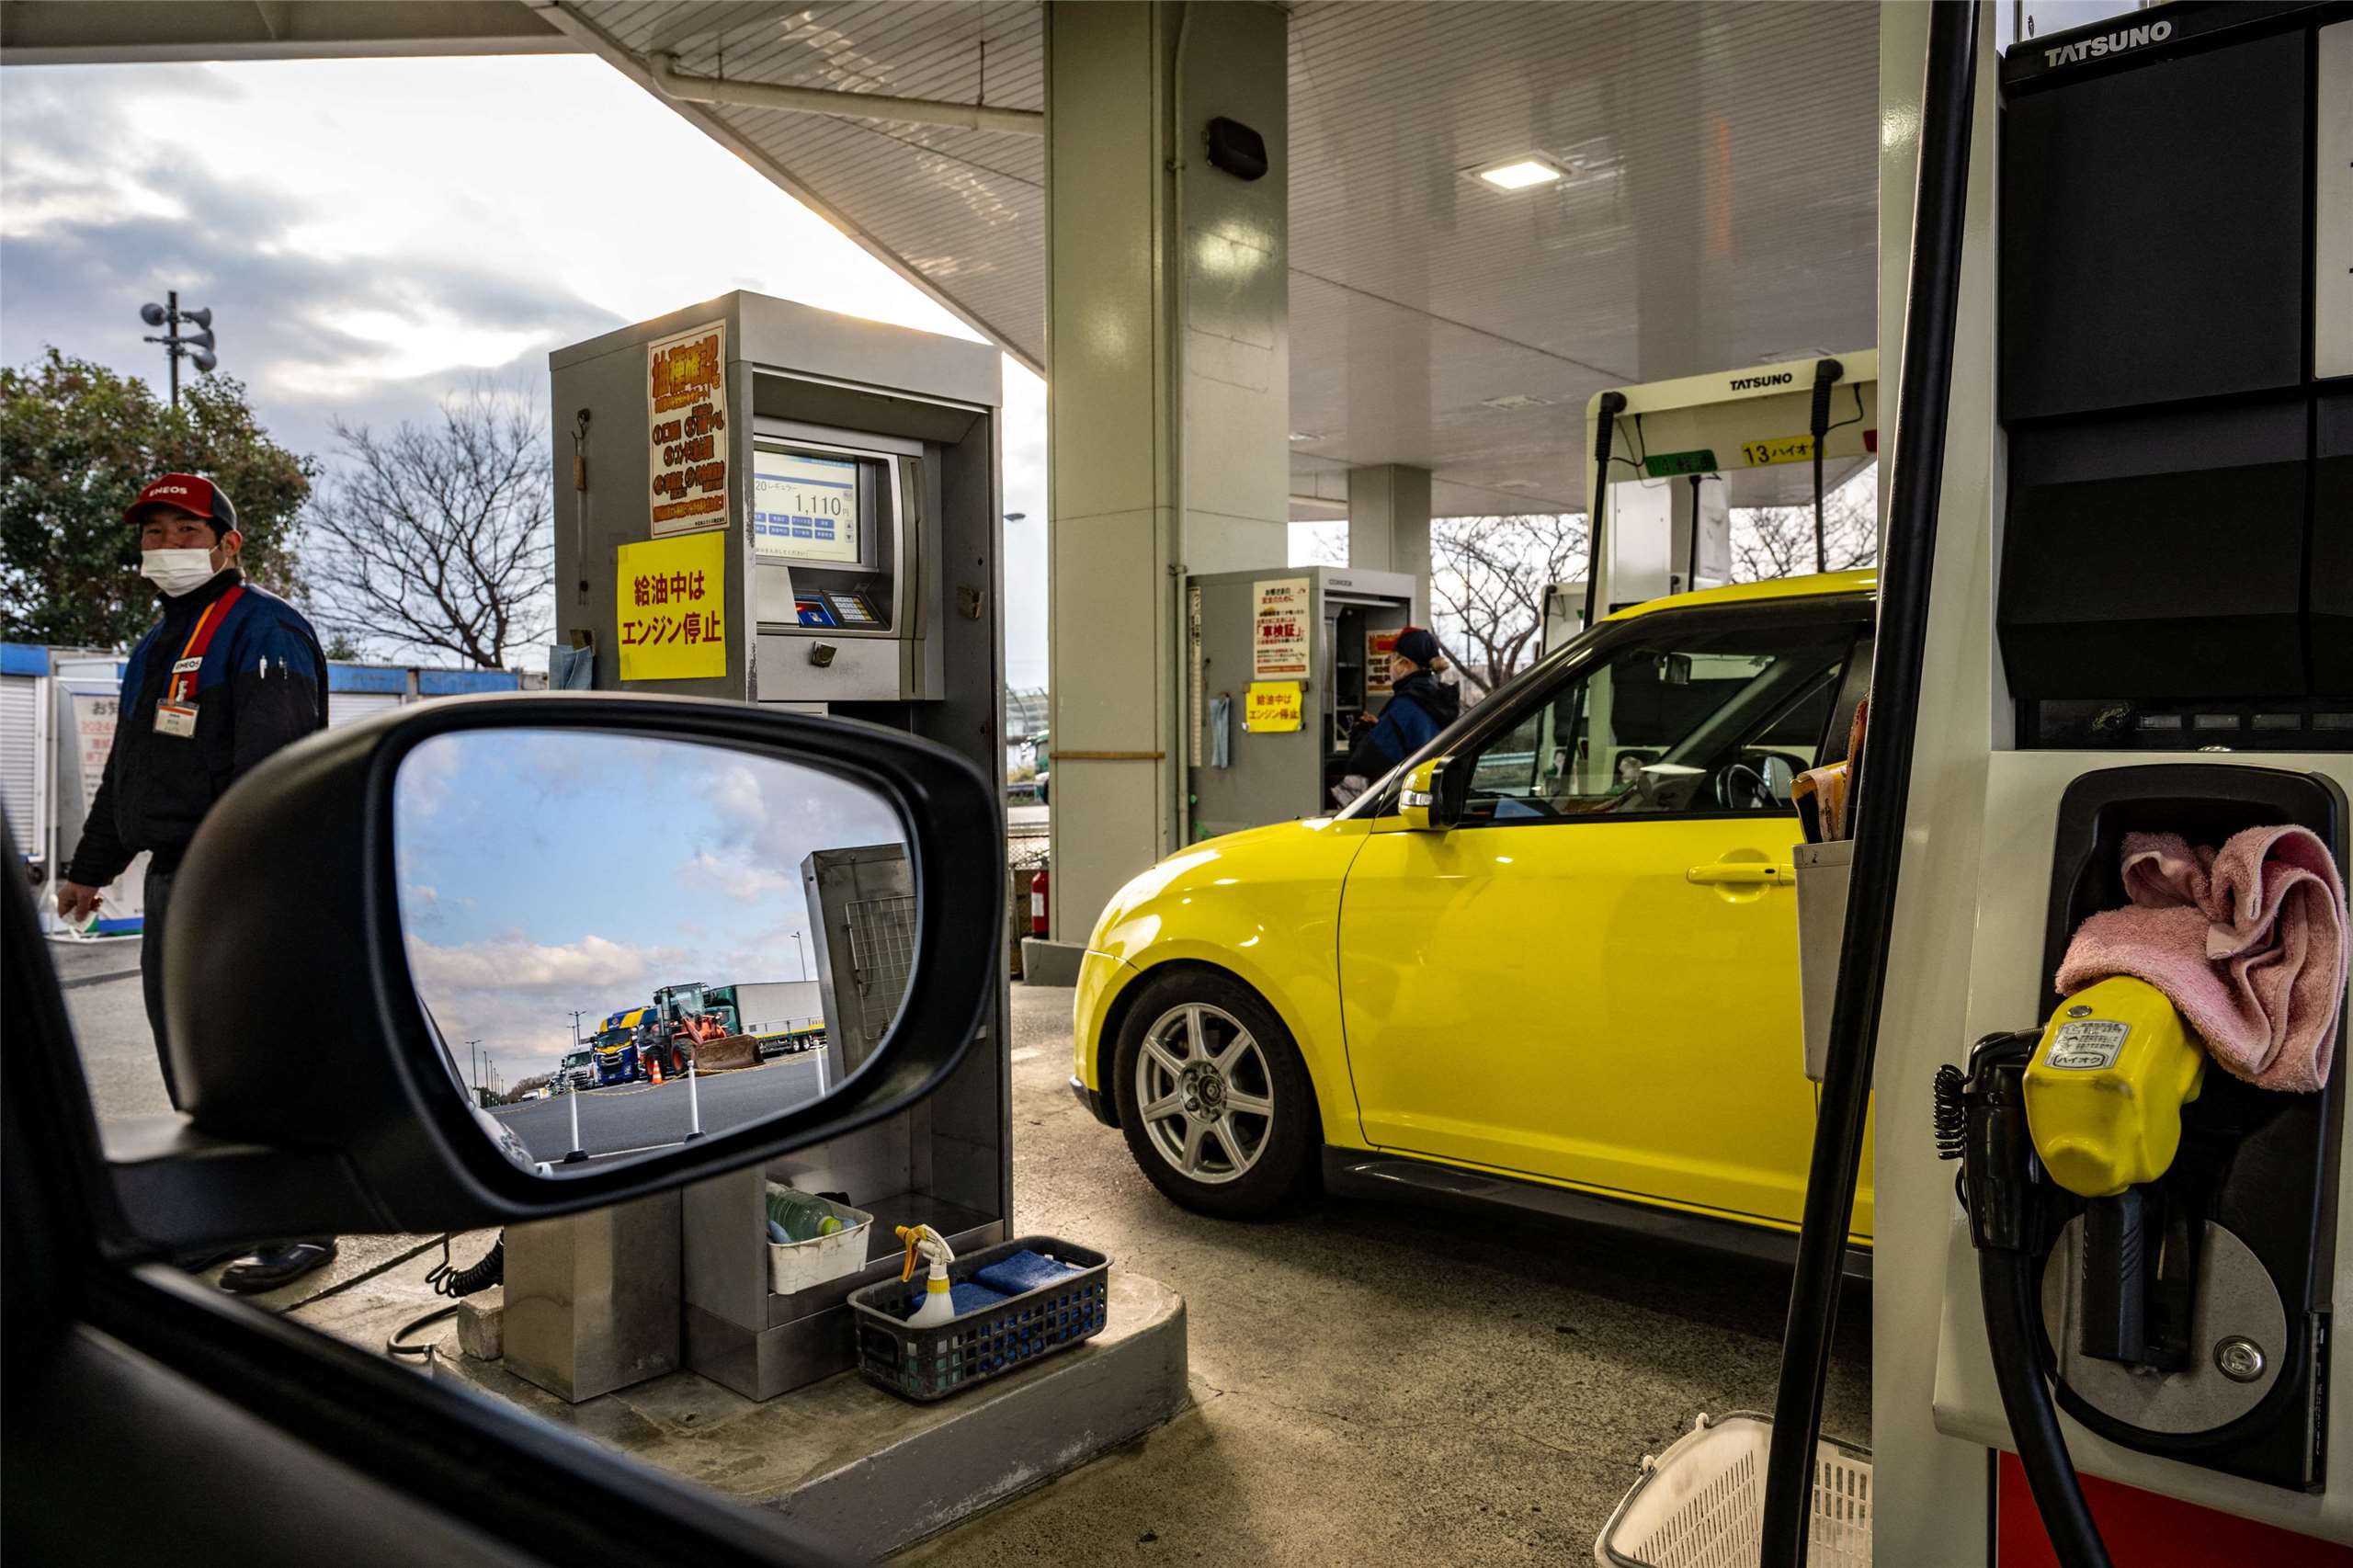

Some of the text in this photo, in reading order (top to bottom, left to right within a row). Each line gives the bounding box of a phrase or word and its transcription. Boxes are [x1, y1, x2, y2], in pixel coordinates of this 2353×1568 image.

[2045, 20, 2173, 68] TATSUNO
[1730, 372, 1793, 392] TATSUNO
[1772, 442, 1815, 458] ハイオ
[634, 570, 705, 607] 給油中は
[622, 609, 722, 646] エンジン停止
